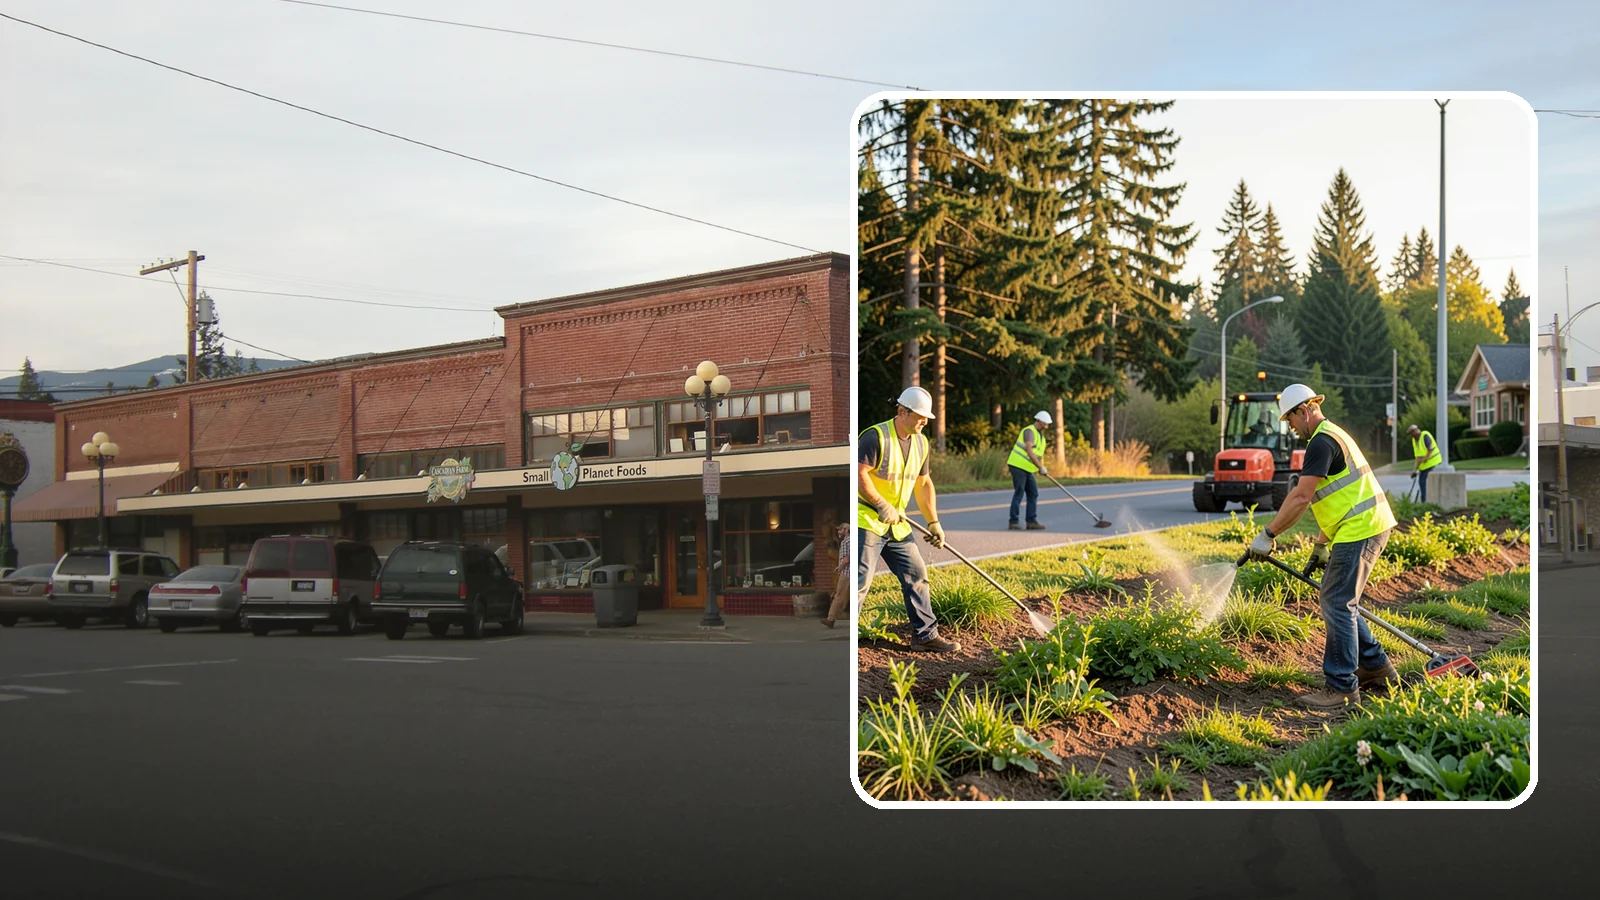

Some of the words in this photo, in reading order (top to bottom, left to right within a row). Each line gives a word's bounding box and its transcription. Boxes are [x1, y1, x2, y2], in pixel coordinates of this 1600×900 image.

[523, 471, 549, 483] Small
[583, 467, 614, 479] Planet
[617, 464, 647, 477] Foods
